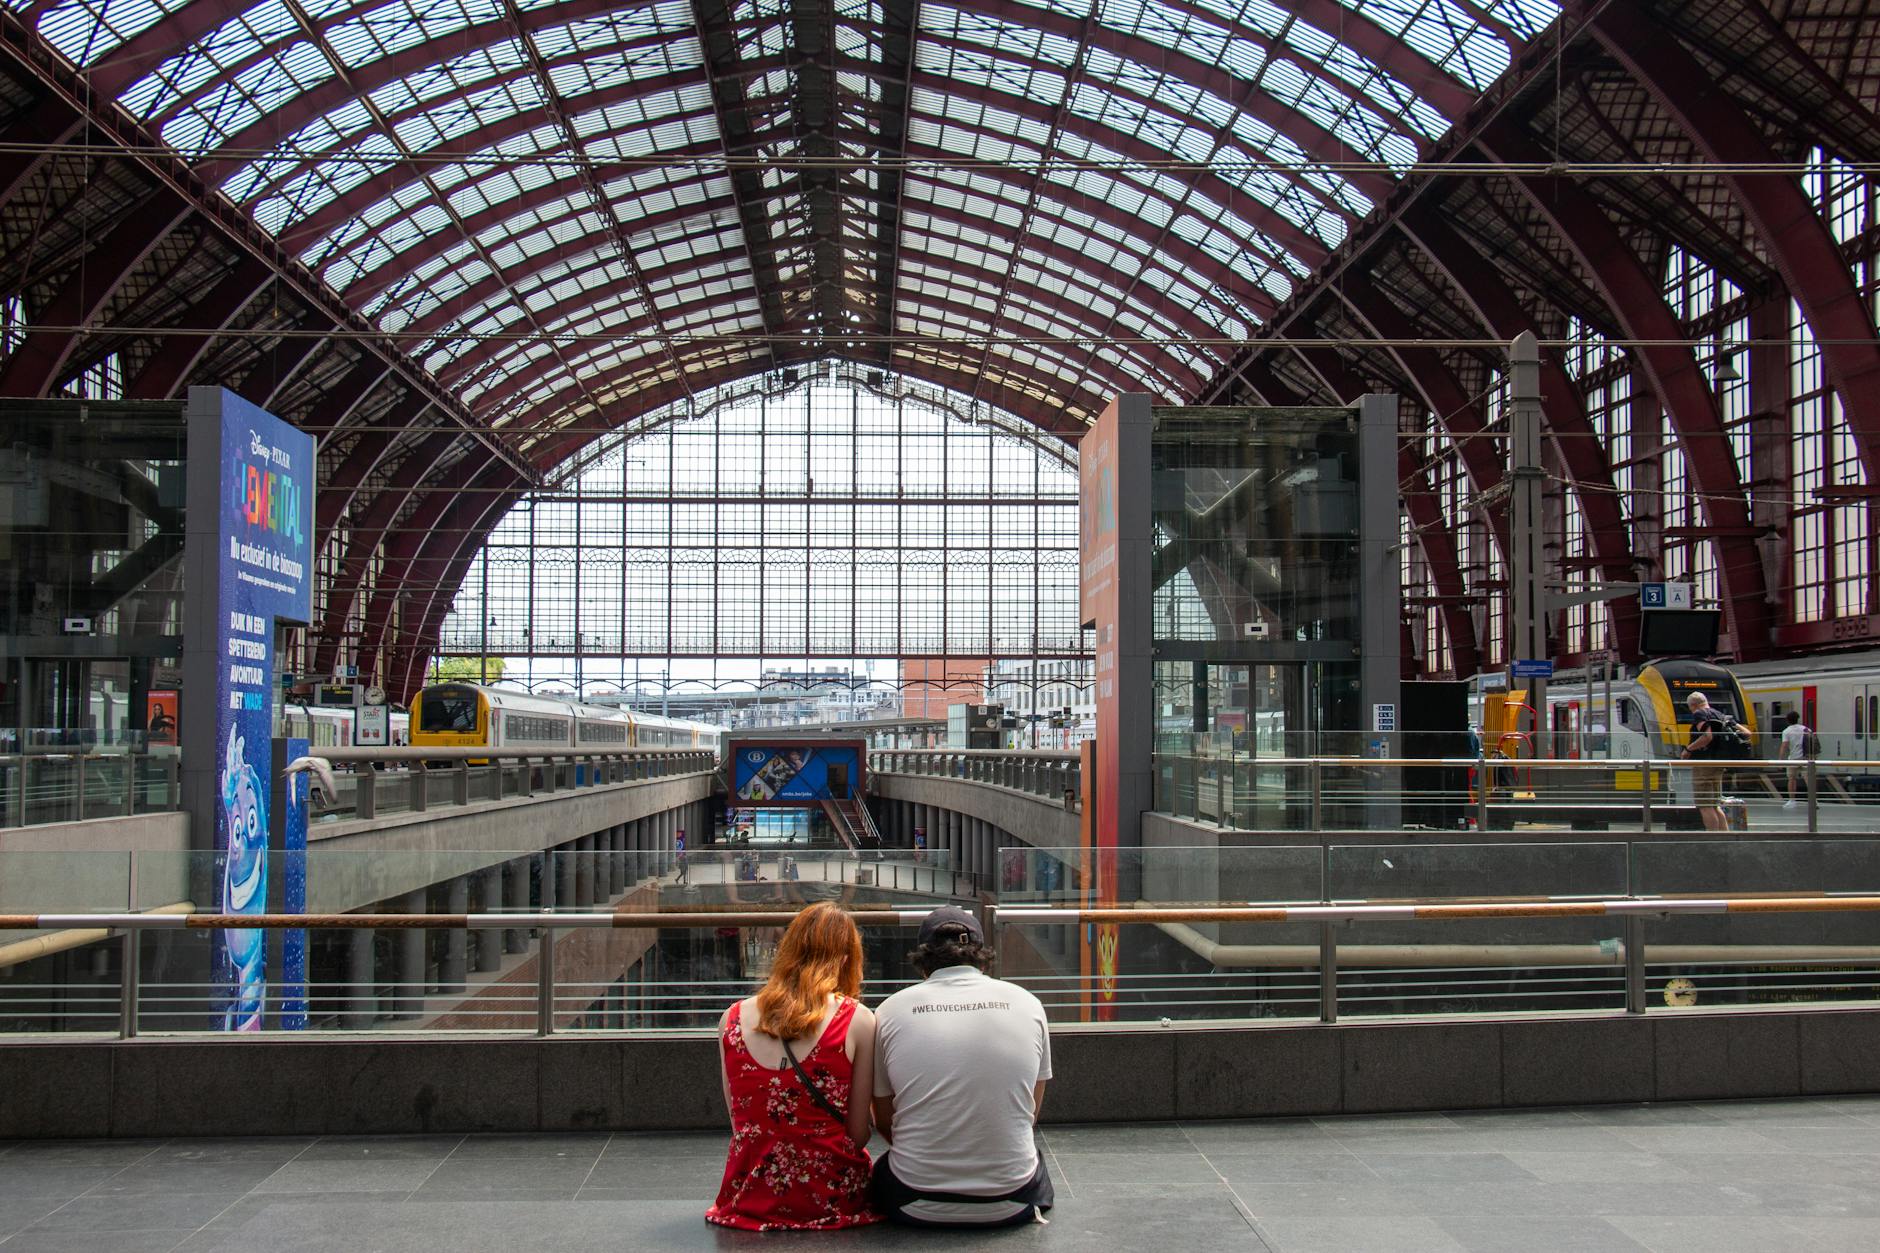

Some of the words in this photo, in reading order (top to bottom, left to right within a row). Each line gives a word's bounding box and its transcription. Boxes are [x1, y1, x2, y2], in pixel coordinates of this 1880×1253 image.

[272, 446, 291, 470] PIXAR
[232, 449, 303, 545] ELEMENTAL
[231, 535, 240, 560] Nu
[241, 542, 266, 568] exclusief
[265, 547, 272, 570] in
[272, 550, 280, 572] de
[280, 552, 303, 584] bioscoop
[1650, 592, 1657, 602] 3
[1674, 593, 1681, 602] A
[231, 611, 246, 632] DUIK
[246, 614, 253, 633] IN
[253, 616, 265, 635] EEN
[228, 638, 266, 661] SPETTEREND
[230, 664, 264, 686] AVONTUUR
[230, 690, 243, 710] MET
[244, 692, 263, 711] WADE
[912, 1001, 1010, 1015] #WELOVECHEZALBERT
